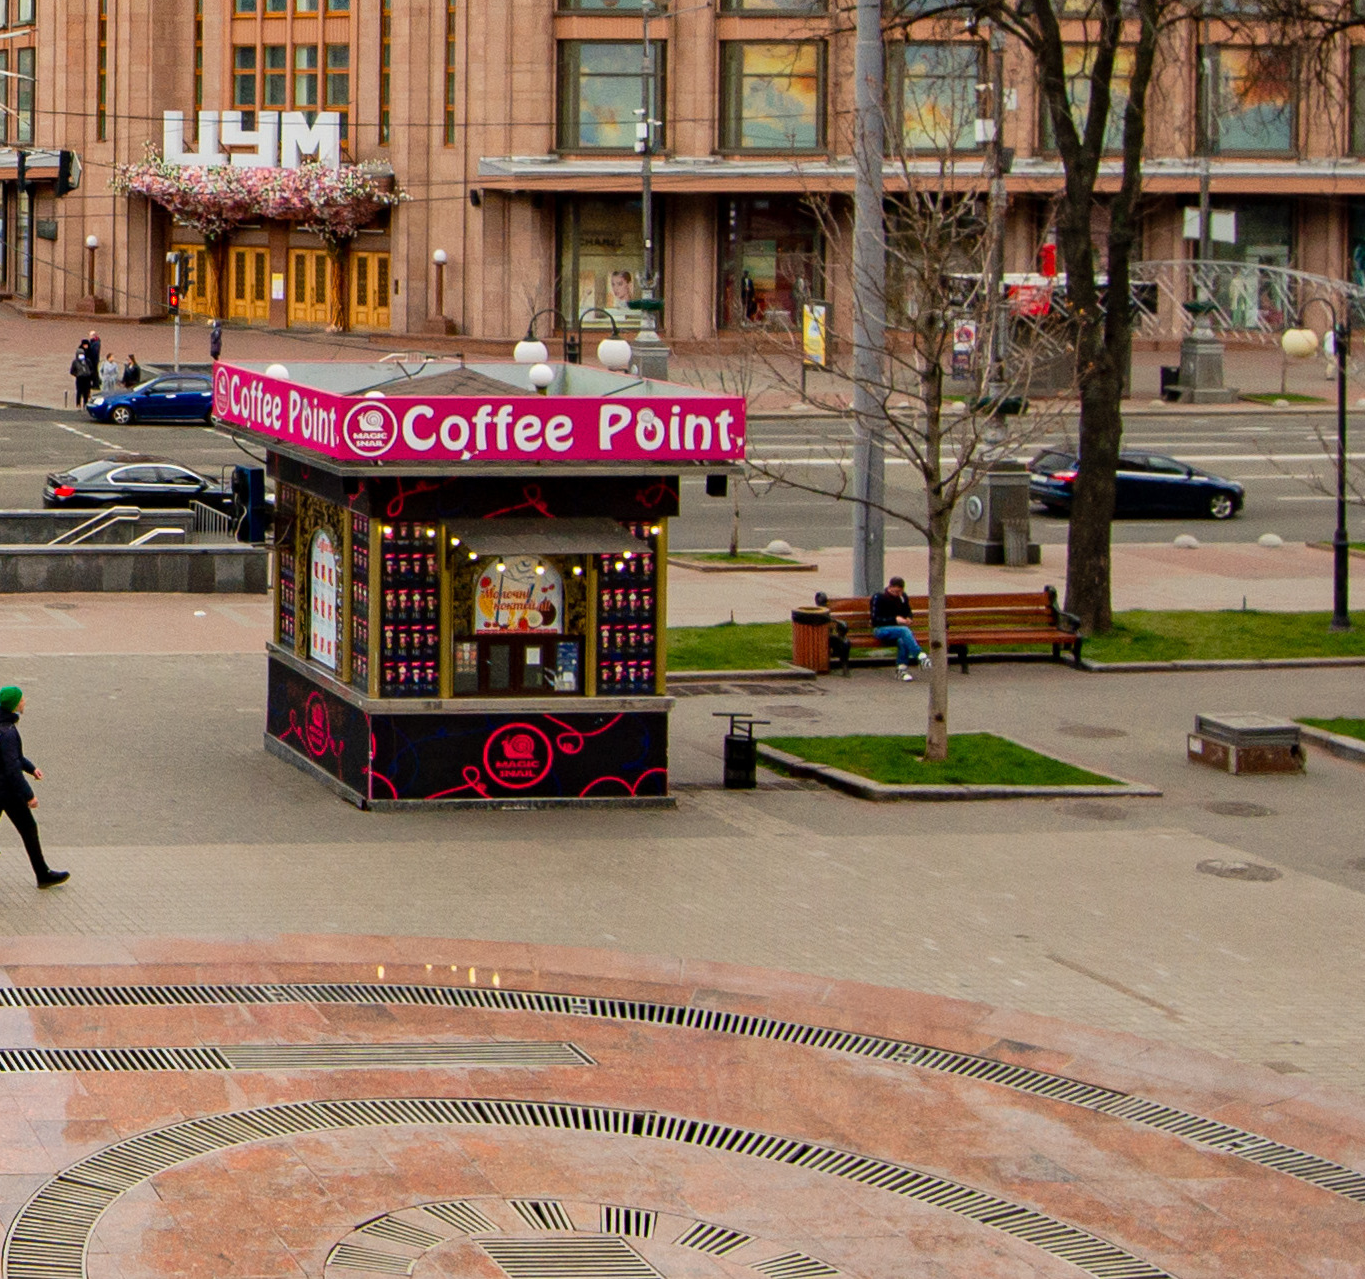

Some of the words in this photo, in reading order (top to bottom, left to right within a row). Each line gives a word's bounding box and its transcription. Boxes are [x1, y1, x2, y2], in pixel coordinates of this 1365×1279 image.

[163, 110, 341, 174] ЦУМ
[231, 375, 282, 431] Coffee
[289, 390, 336, 448] Point
[402, 404, 573, 452] Coffee
[599, 404, 733, 452] Point
[495, 760, 539, 769] MAGIC
[499, 770, 537, 778] SNAIL
